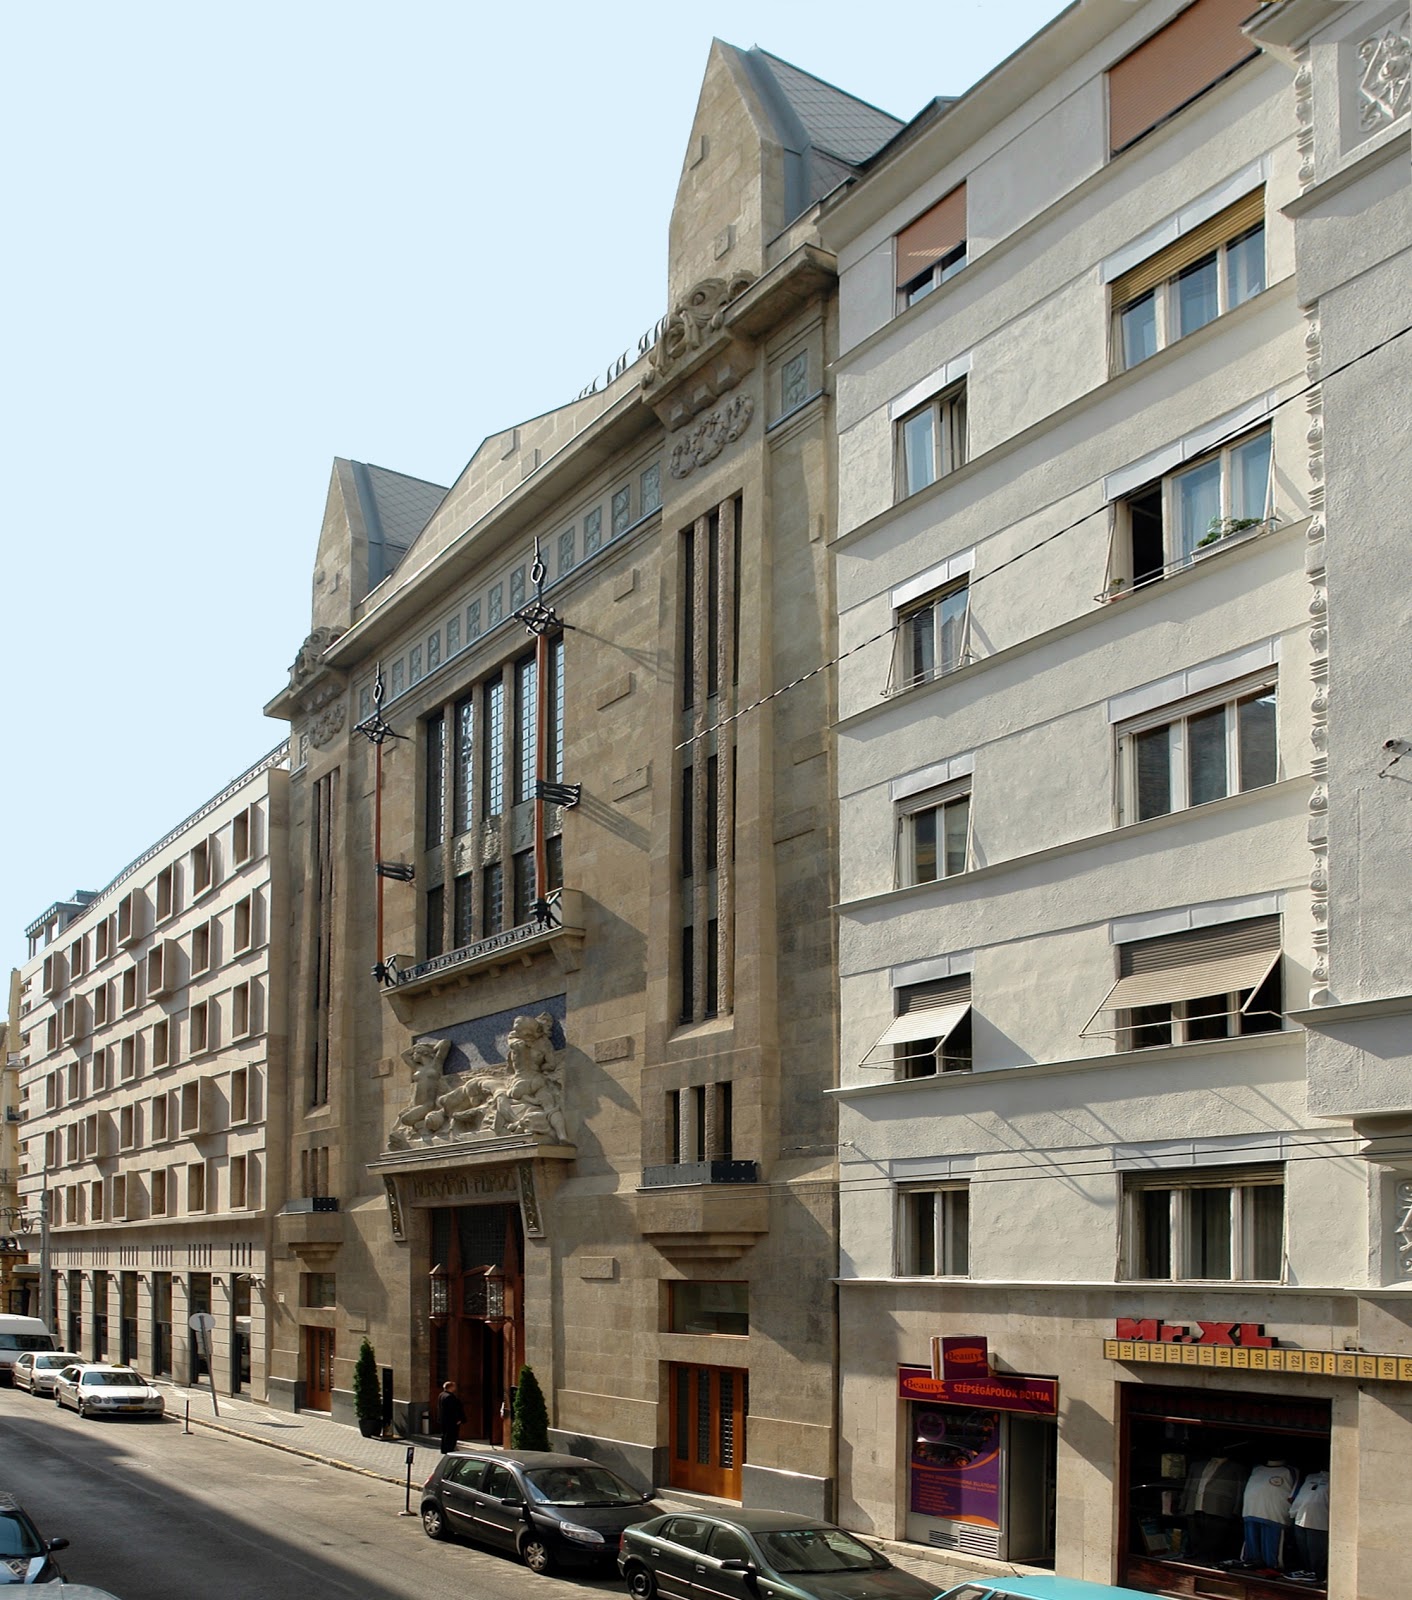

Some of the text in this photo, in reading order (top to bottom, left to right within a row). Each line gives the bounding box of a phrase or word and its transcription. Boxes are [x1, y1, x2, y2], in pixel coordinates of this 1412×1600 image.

[947, 1352, 980, 1361] Beauty
[1238, 1352, 1246, 1365] 119
[1255, 1353, 1264, 1367] 120
[1273, 1355, 1281, 1368] 121
[1291, 1355, 1300, 1368] 122
[1310, 1356, 1319, 1370] 123
[1344, 1359, 1352, 1373] 126
[1364, 1361, 1372, 1374] 127
[1384, 1362, 1393, 1376] 128
[906, 1379, 941, 1392] Beauty
[1020, 1390, 1050, 1401] BOLTJA
